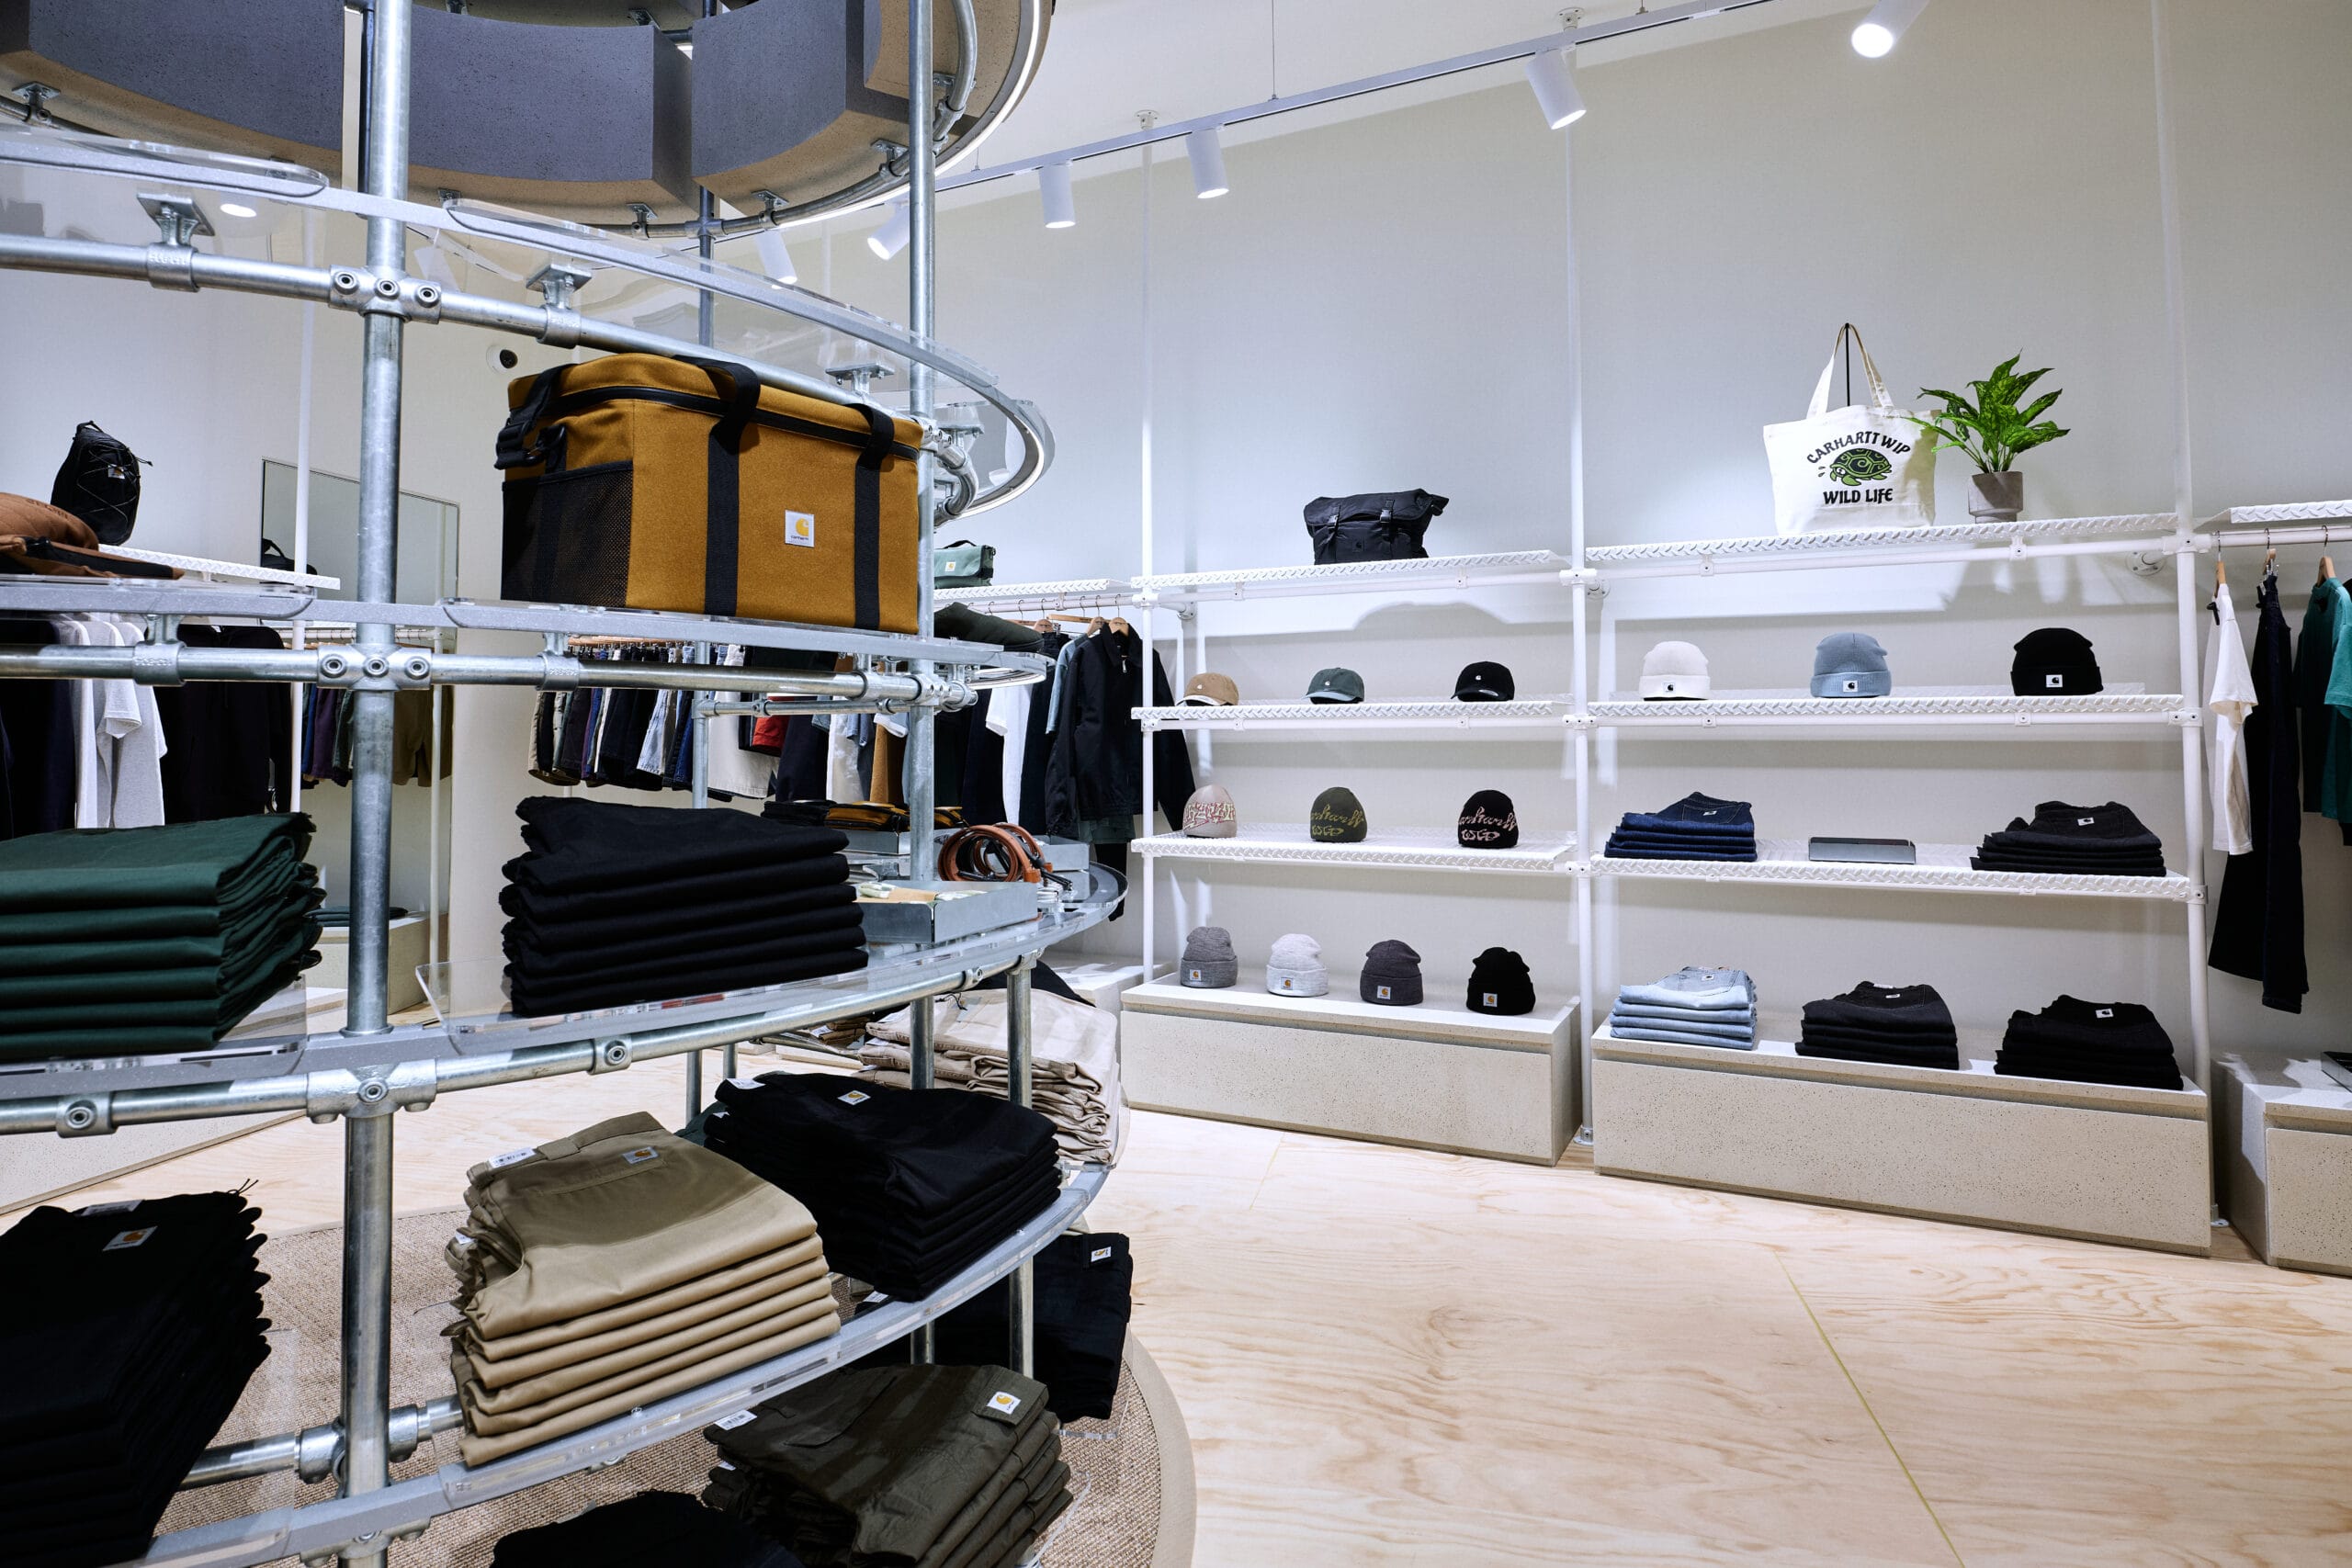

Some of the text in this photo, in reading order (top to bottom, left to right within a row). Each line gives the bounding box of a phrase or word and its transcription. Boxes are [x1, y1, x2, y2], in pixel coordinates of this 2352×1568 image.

[1807, 431, 1911, 463] CARHARTT WIP
[1823, 488, 1894, 504] WILD LIFE
